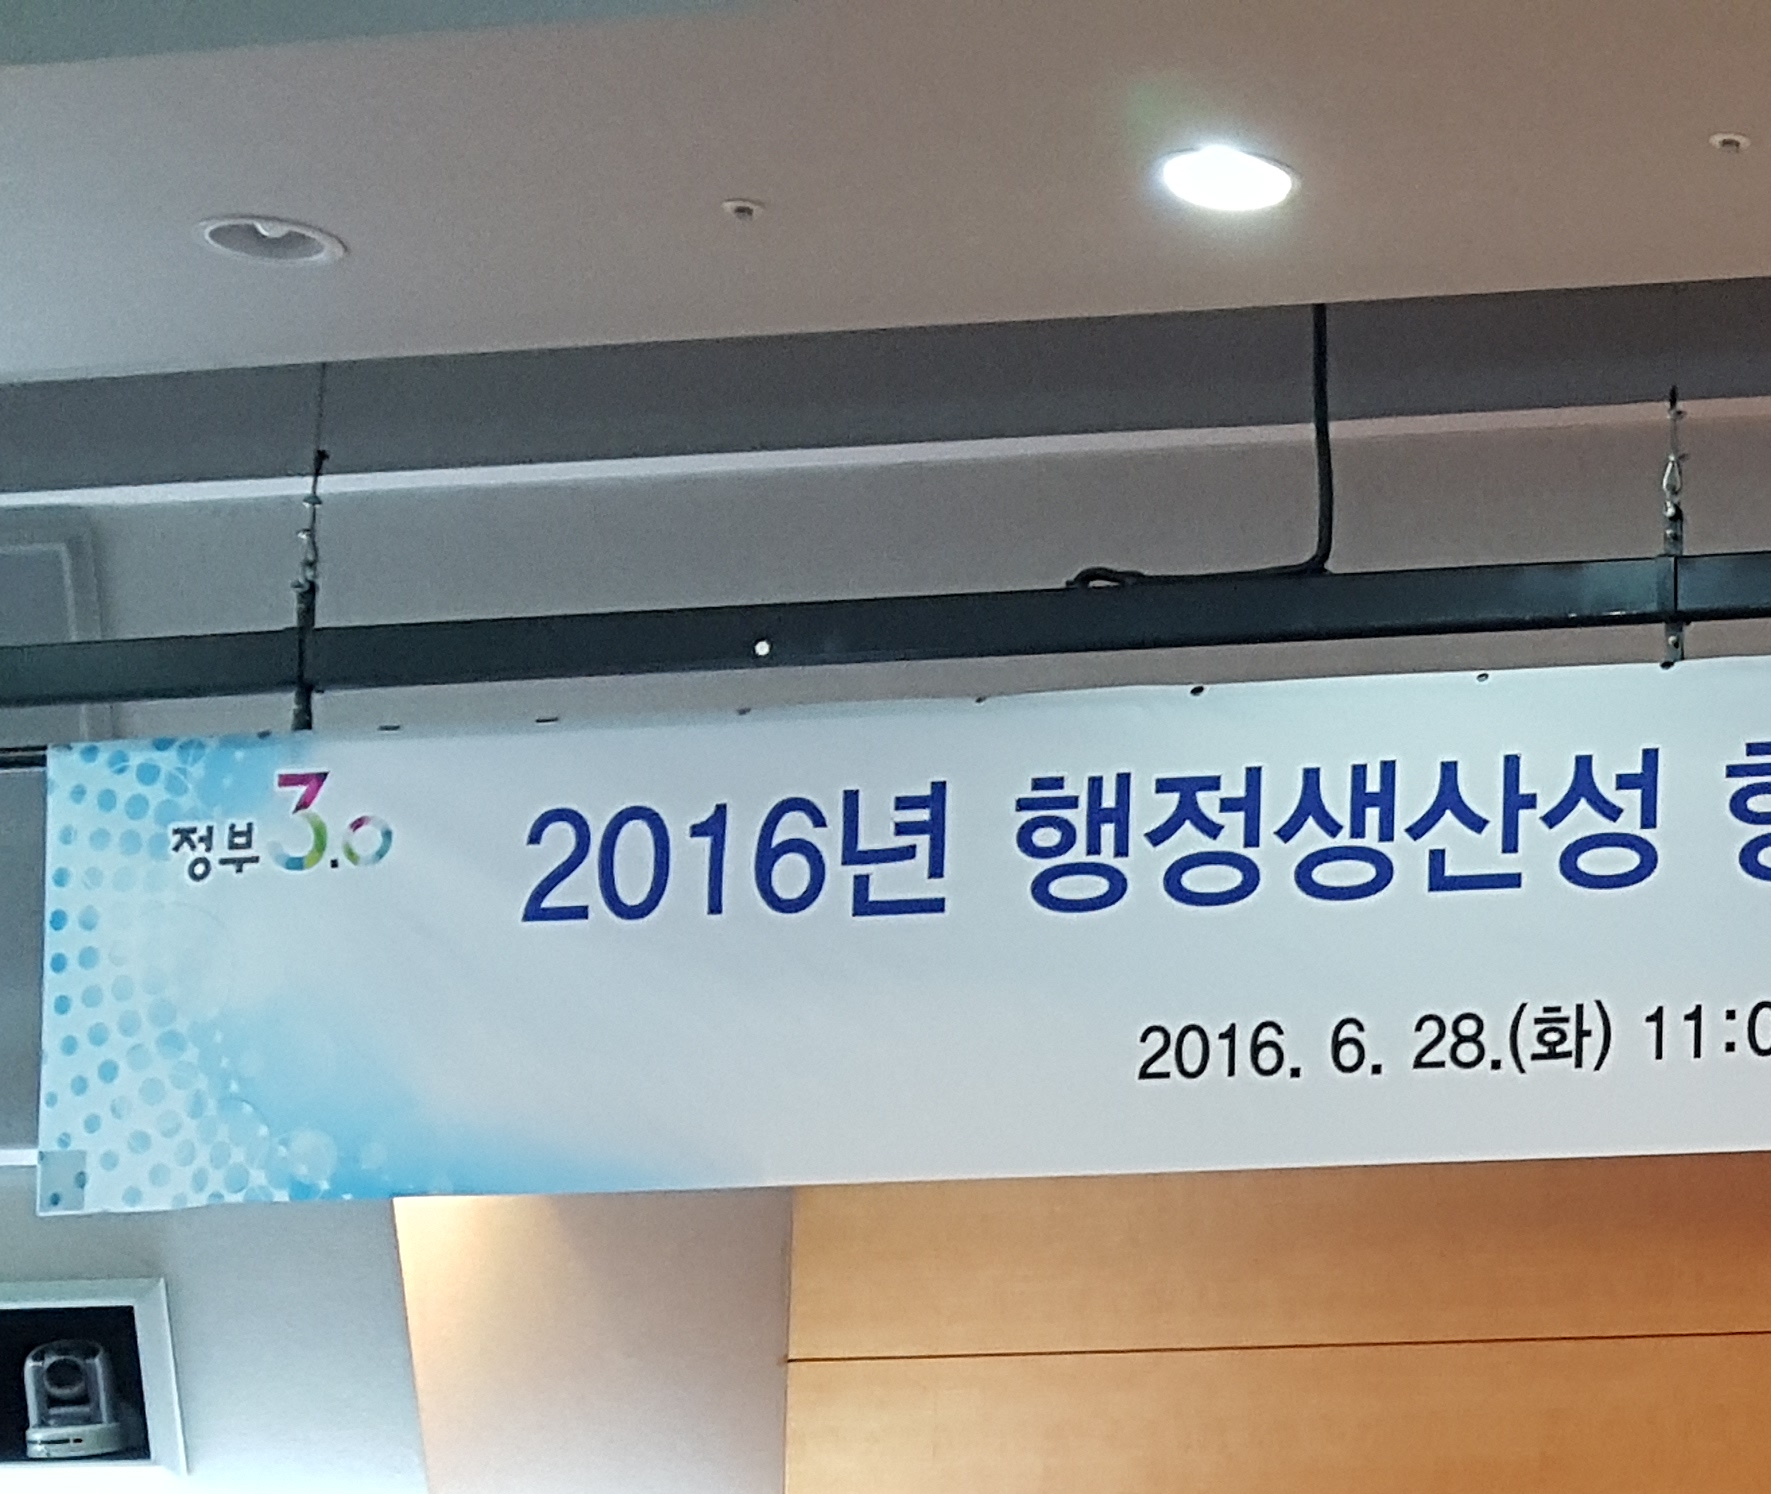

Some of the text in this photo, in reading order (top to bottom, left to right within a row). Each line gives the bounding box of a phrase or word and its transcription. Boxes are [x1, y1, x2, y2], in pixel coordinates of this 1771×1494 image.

[171, 771, 393, 882] 정부 3.0
[521, 780, 947, 923] 2016년
[1014, 747, 1660, 914] 행정생산성
[1138, 1020, 1301, 1080] 2016.
[1331, 1017, 1383, 1075] 6.
[1412, 999, 1612, 1074] 28.(화)
